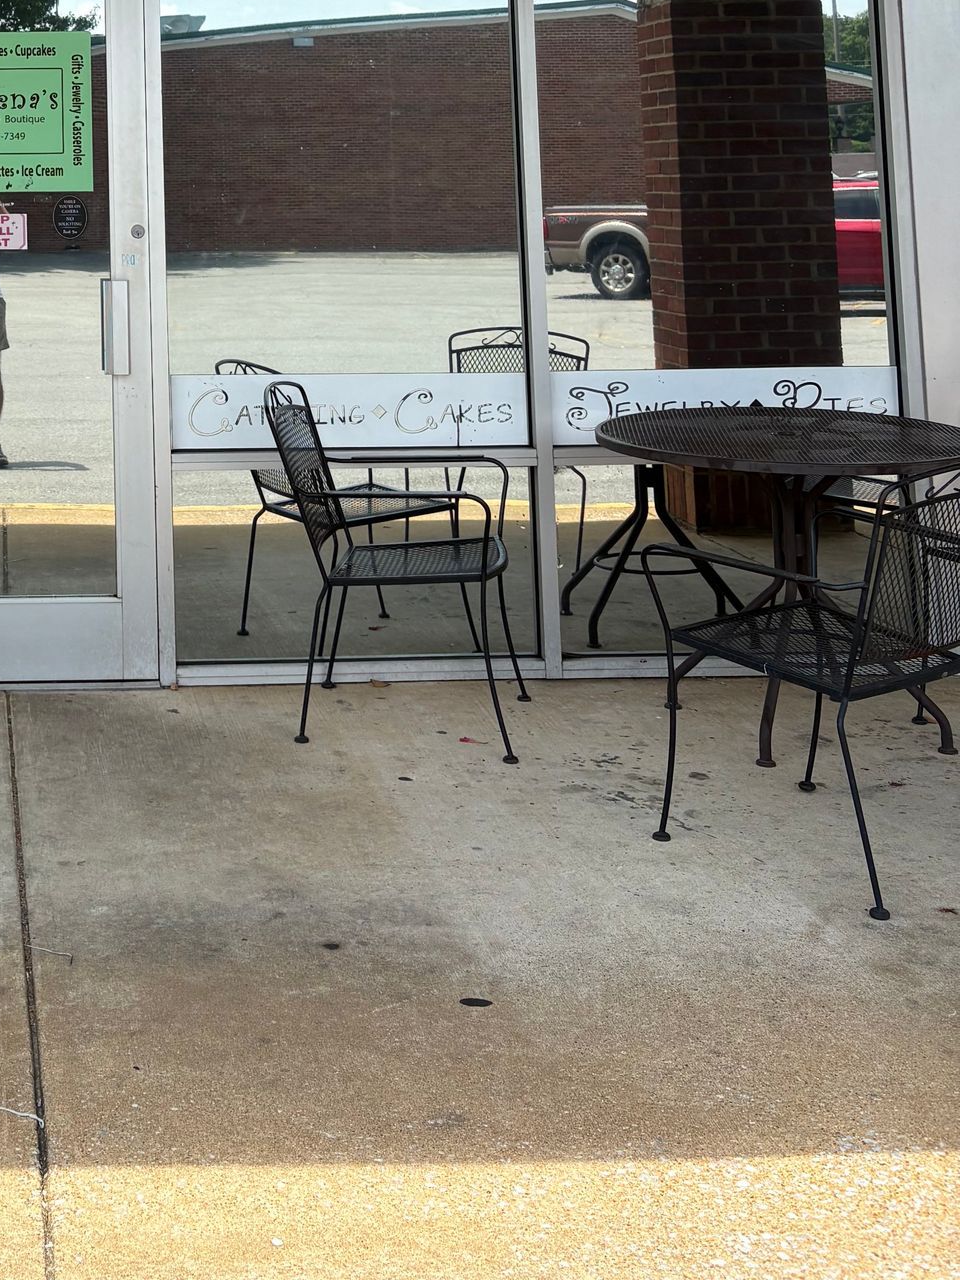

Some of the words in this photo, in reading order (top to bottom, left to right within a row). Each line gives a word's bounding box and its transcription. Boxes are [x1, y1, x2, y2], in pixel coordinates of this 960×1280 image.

[14, 44, 57, 59] Cupcakes
[71, 54, 84, 75] Gifts
[70, 81, 84, 115] Jewelry
[4, 114, 46, 124] Boutique
[71, 120, 86, 166] Casseroles
[21, 165, 34, 177] Ice
[35, 164, 64, 177] Cream
[188, 387, 365, 437] CATING
[394, 387, 514, 434] CAKES
